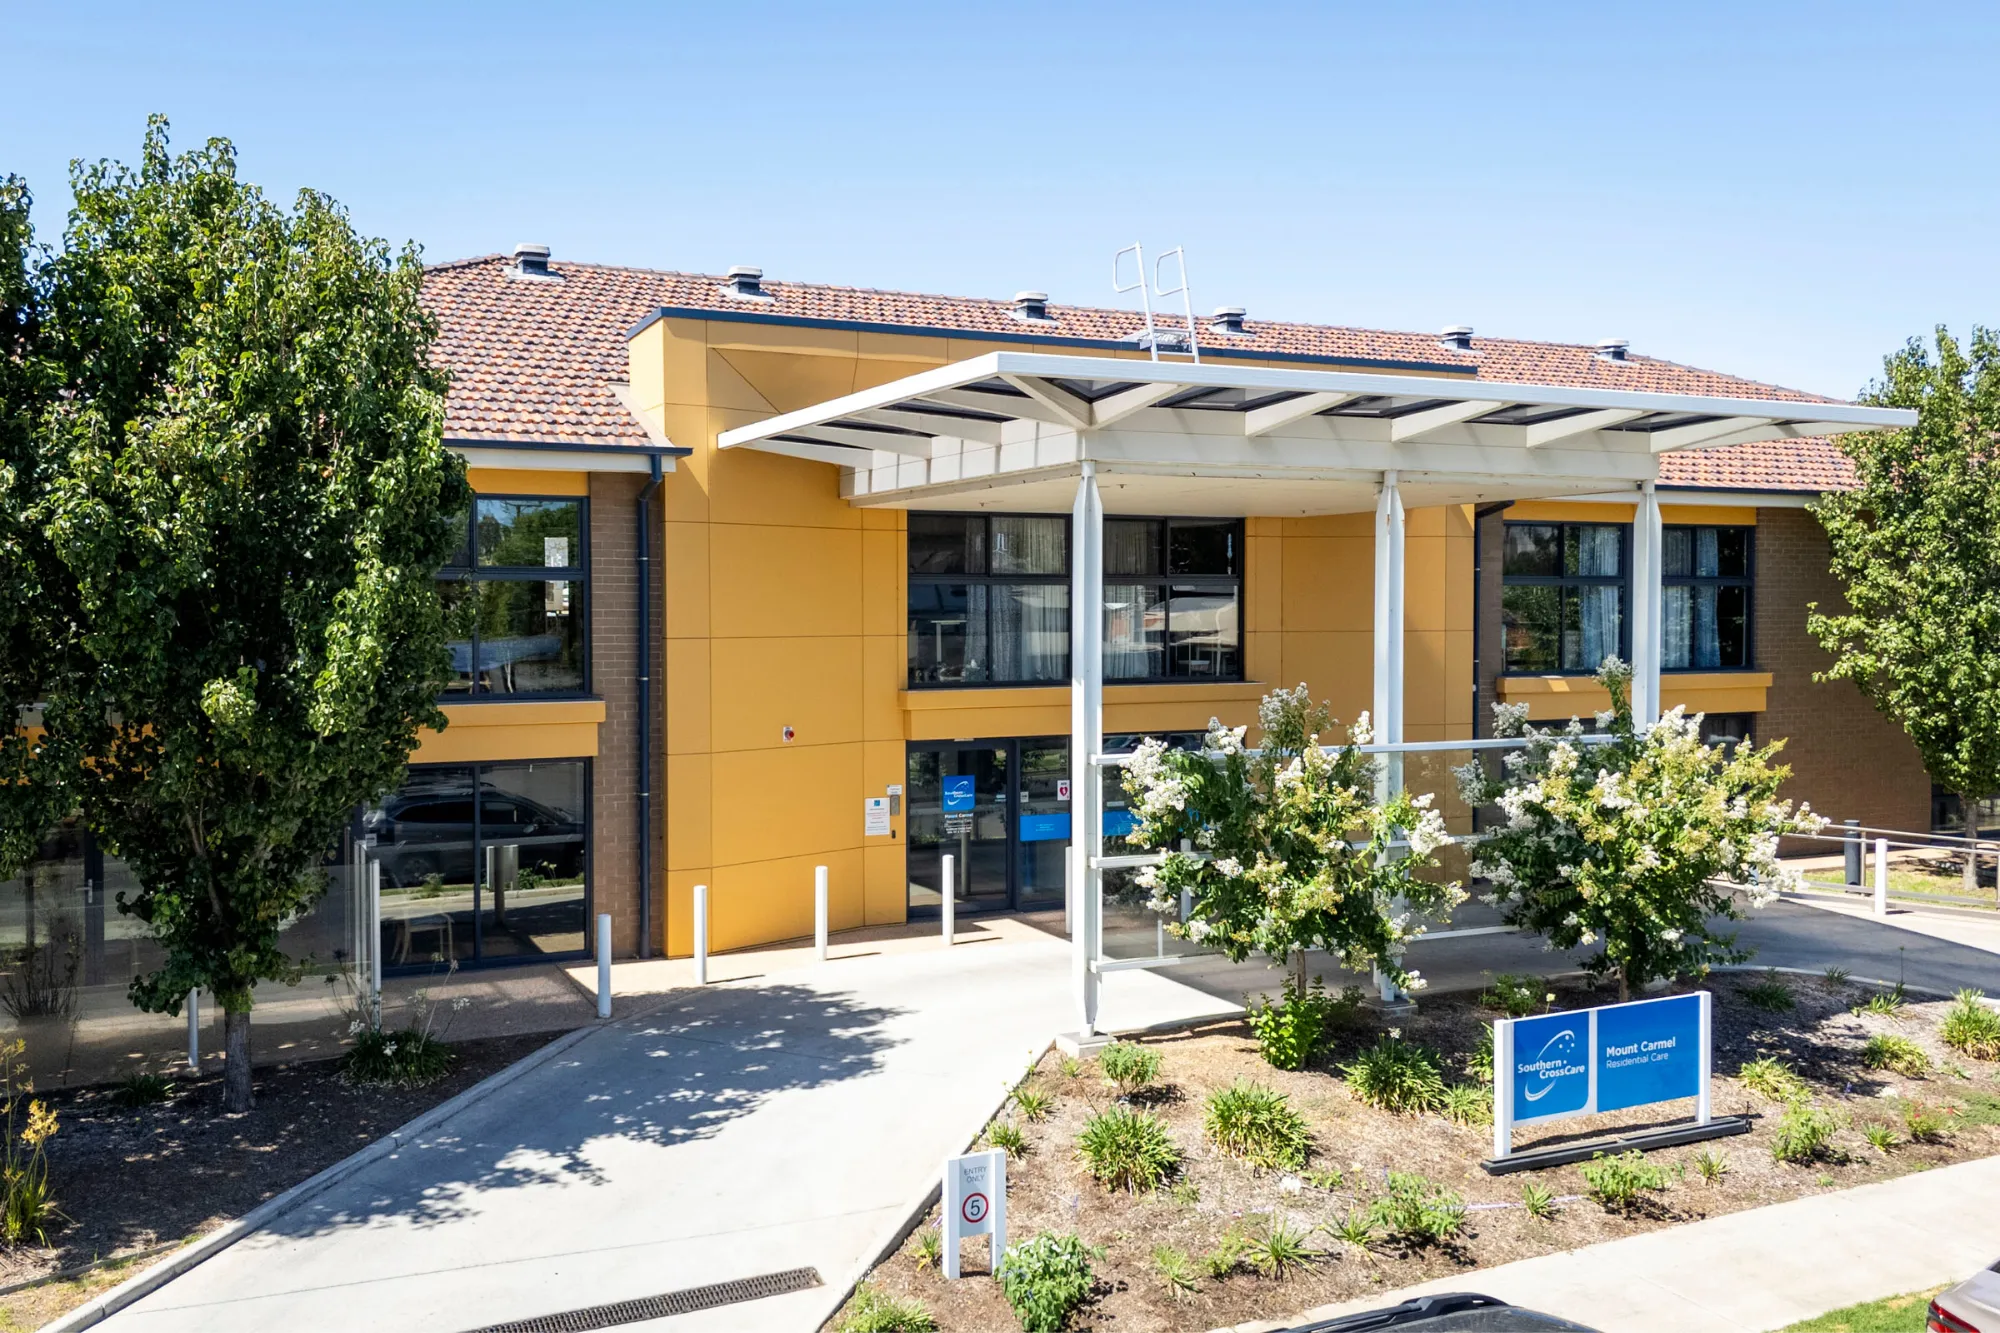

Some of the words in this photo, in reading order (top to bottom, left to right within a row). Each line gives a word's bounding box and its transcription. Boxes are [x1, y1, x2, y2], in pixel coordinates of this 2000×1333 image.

[1606, 1043, 1638, 1057] Mount
[1640, 1036, 1676, 1052] Carmel
[1517, 1060, 1562, 1074] Southern
[1606, 1054, 1648, 1069] Residential
[1650, 1052, 1669, 1062] Care
[1539, 1065, 1586, 1079] CrossCare
[964, 1166, 987, 1176] ENTRY
[966, 1174, 985, 1184] ONLY
[970, 1199, 980, 1217] 5
